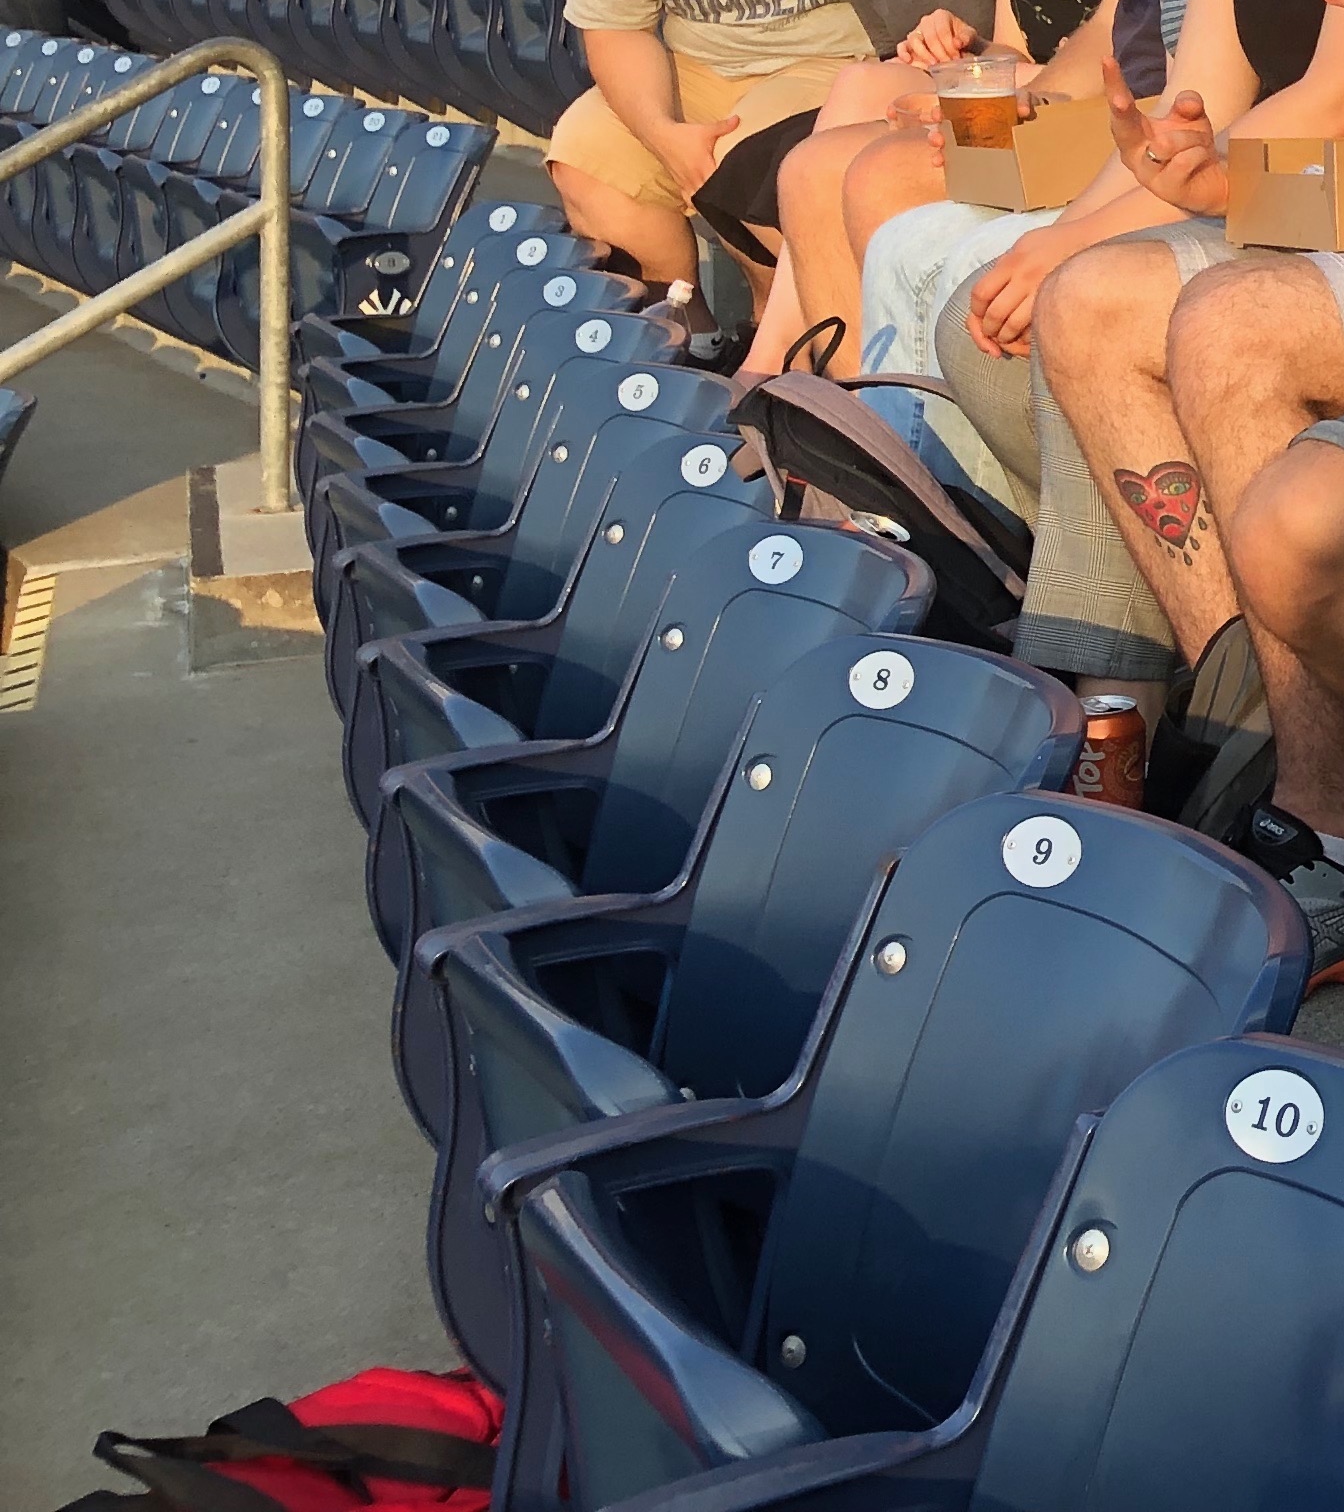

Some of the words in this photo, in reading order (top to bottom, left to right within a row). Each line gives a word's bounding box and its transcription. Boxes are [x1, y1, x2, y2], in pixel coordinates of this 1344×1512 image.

[527, 245, 538, 258] 2
[554, 284, 566, 298] 3
[588, 329, 600, 344] 4
[632, 384, 645, 400] 5
[698, 457, 712, 475] 6
[770, 551, 786, 570] 7
[872, 668, 892, 691] 8
[1031, 837, 1054, 866] 9
[1250, 1095, 1302, 1139] 10
